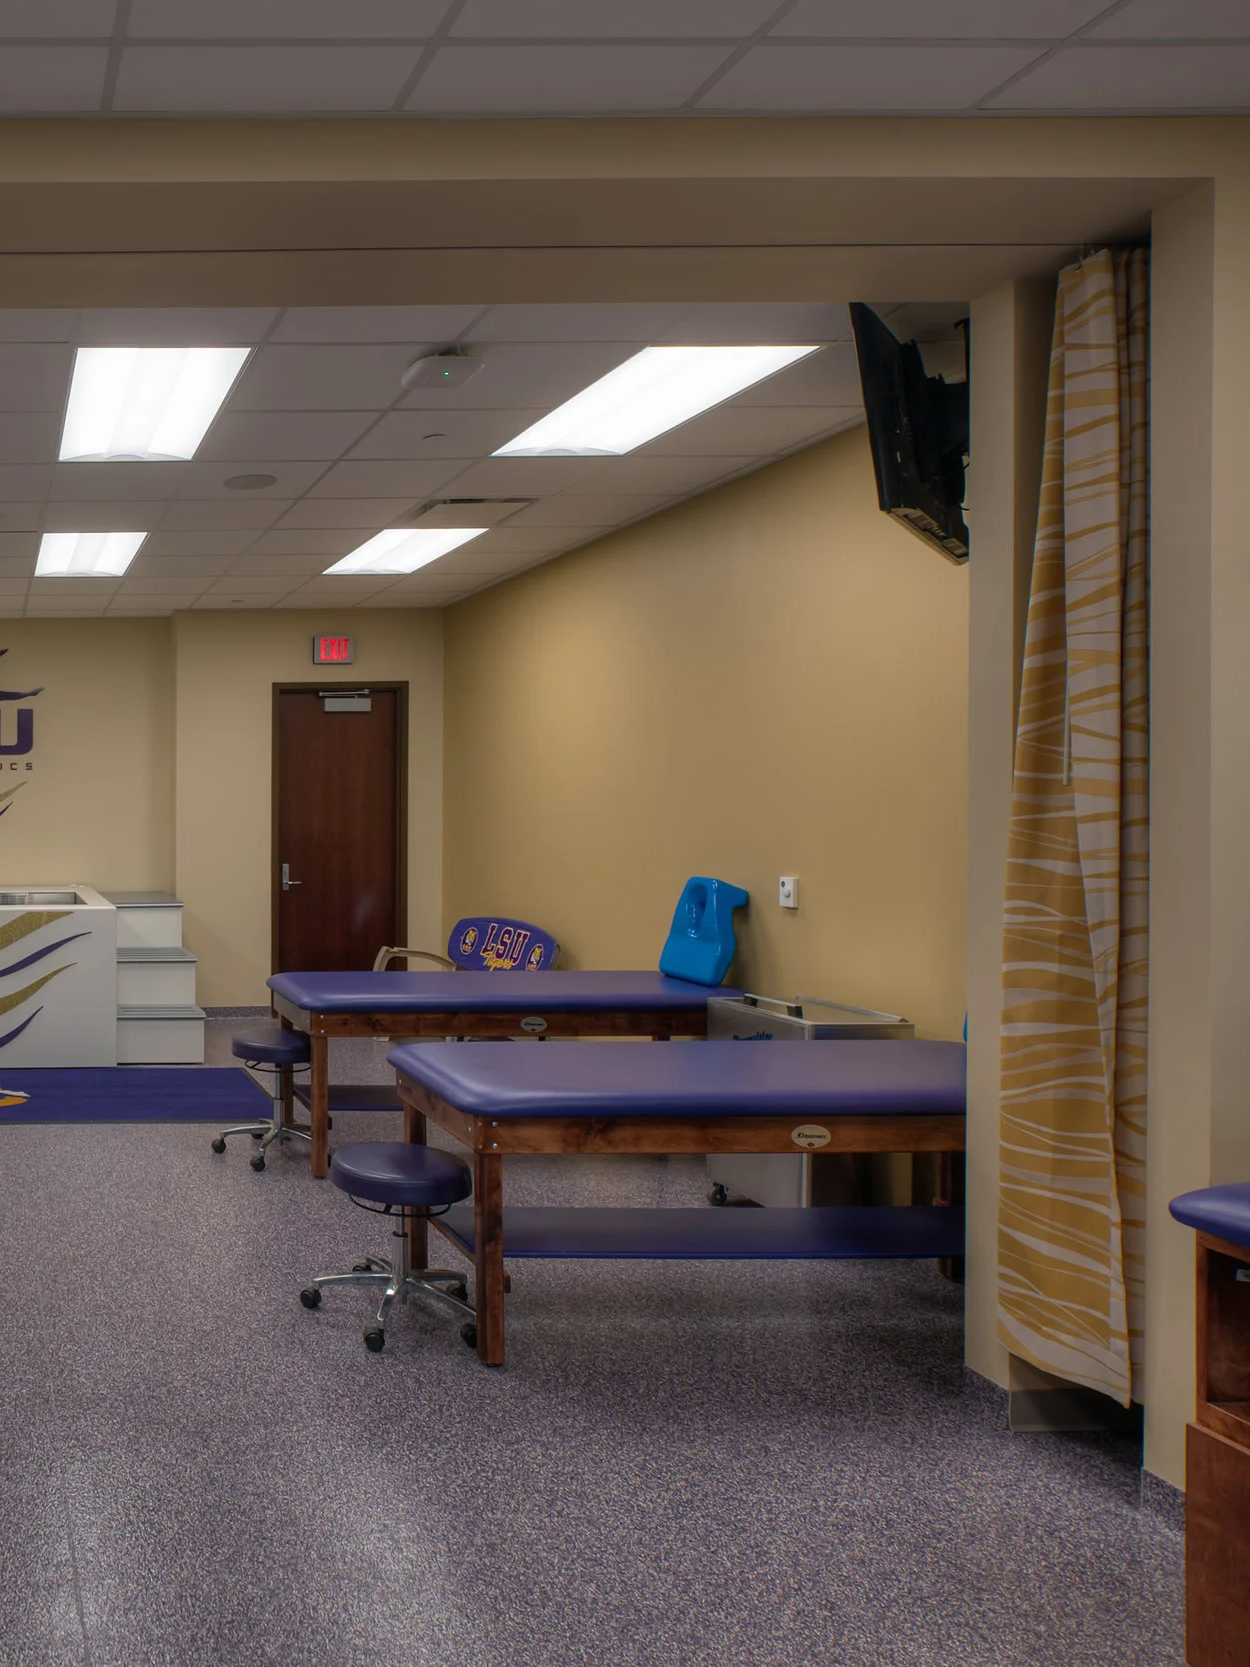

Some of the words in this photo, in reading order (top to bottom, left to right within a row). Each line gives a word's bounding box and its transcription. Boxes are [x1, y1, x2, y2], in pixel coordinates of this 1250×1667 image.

[320, 638, 349, 661] EXIT
[480, 923, 530, 965] LSU
[481, 951, 513, 972] Tigers
